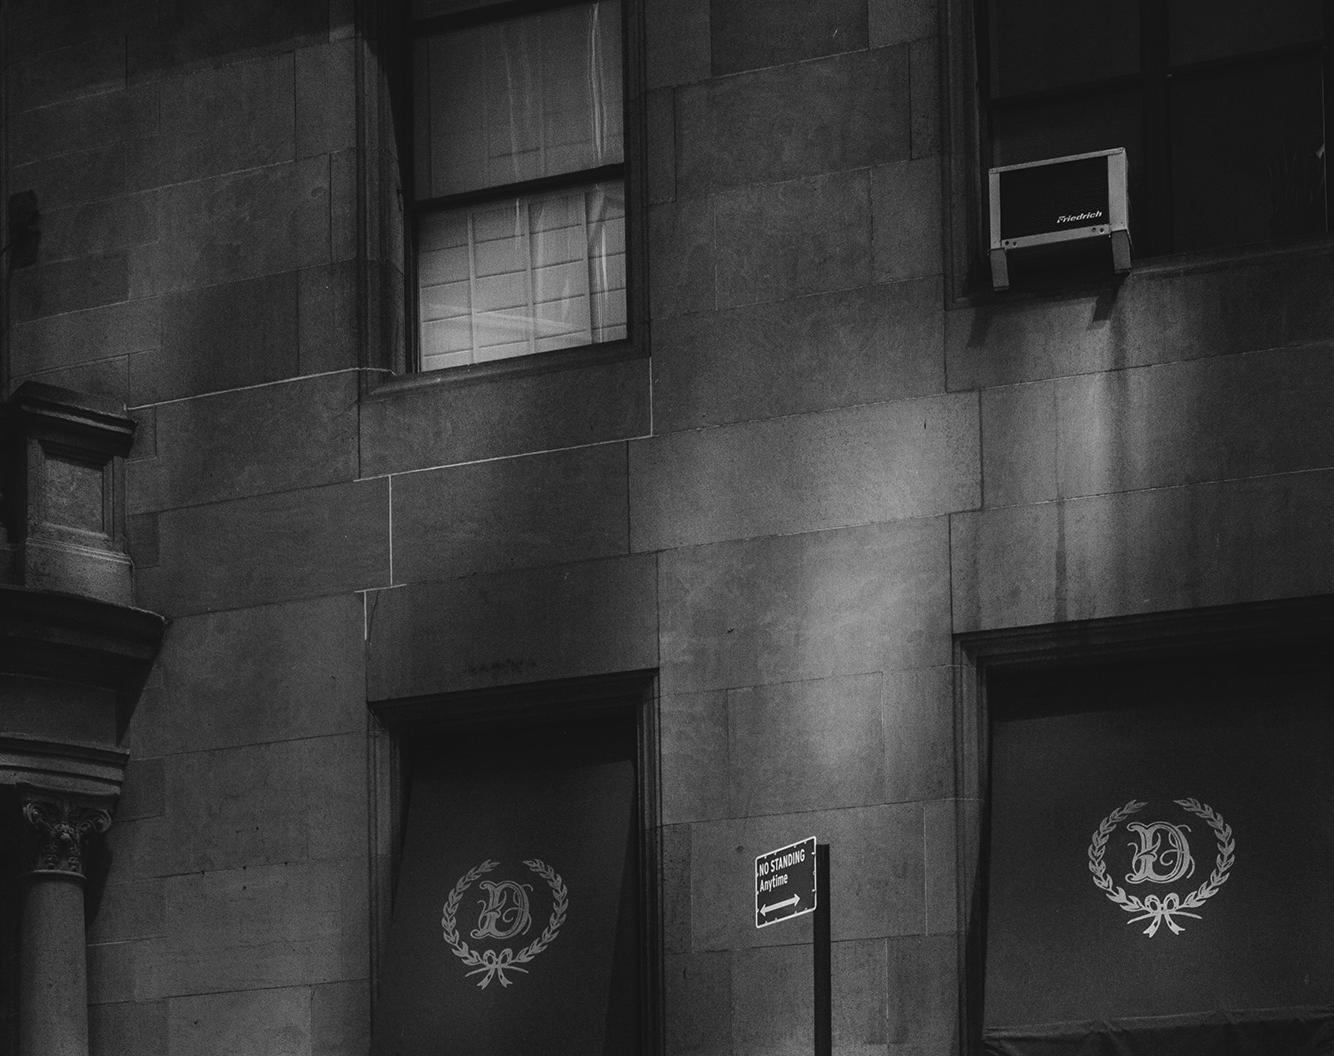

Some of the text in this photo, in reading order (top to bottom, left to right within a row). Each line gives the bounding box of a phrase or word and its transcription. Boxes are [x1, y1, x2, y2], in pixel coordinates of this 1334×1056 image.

[1056, 210, 1103, 224] Friedrich
[759, 848, 805, 877] NO STANDING
[759, 873, 788, 893] Anytime
